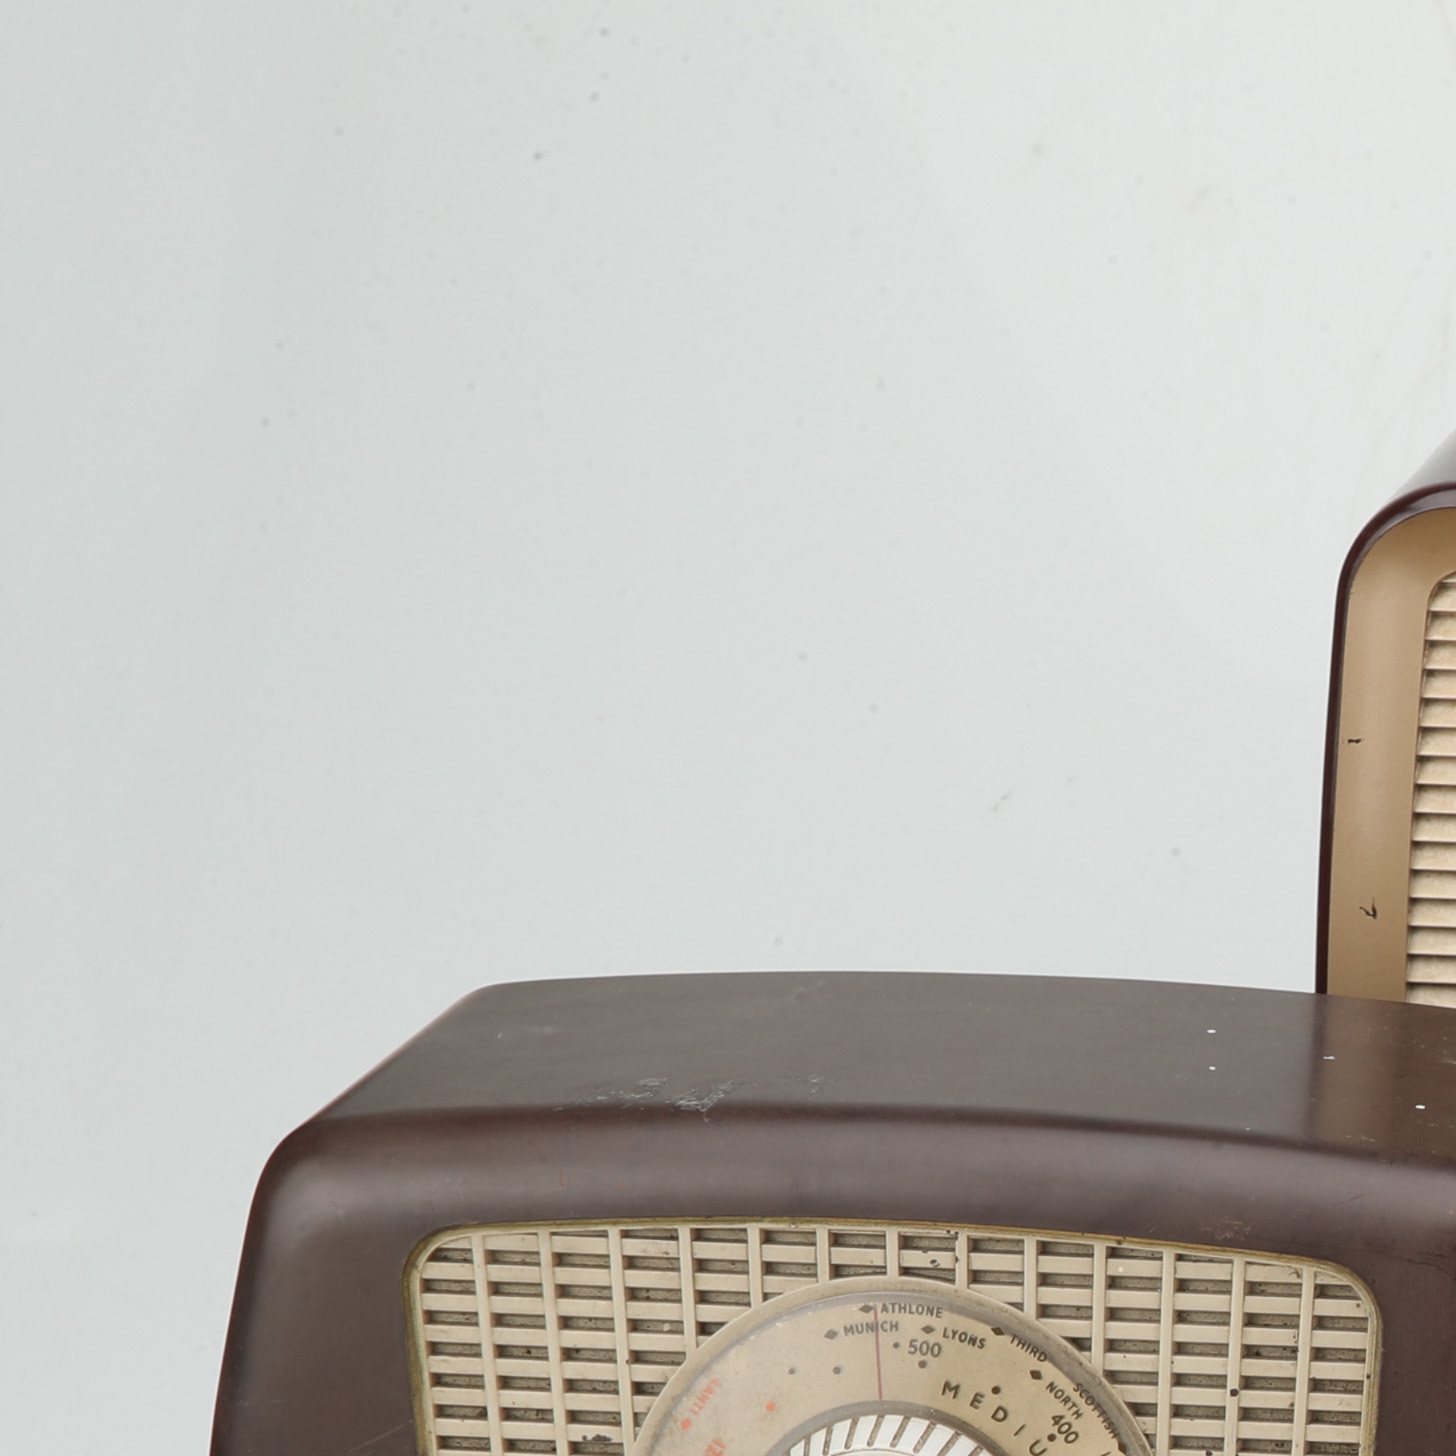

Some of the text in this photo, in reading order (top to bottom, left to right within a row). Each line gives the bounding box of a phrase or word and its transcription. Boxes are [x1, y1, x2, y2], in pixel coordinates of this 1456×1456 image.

[880, 1303, 943, 1318] ATHLONE
[843, 1320, 899, 1337] MUNICH
[942, 1327, 986, 1350] LYONS
[908, 1339, 942, 1358] 500
[1009, 1334, 1048, 1363] THIRD
[1045, 1381, 1084, 1421] NORTH
[1073, 1382, 1120, 1440] SCOTTISH
[1051, 1413, 1079, 1445] 400
